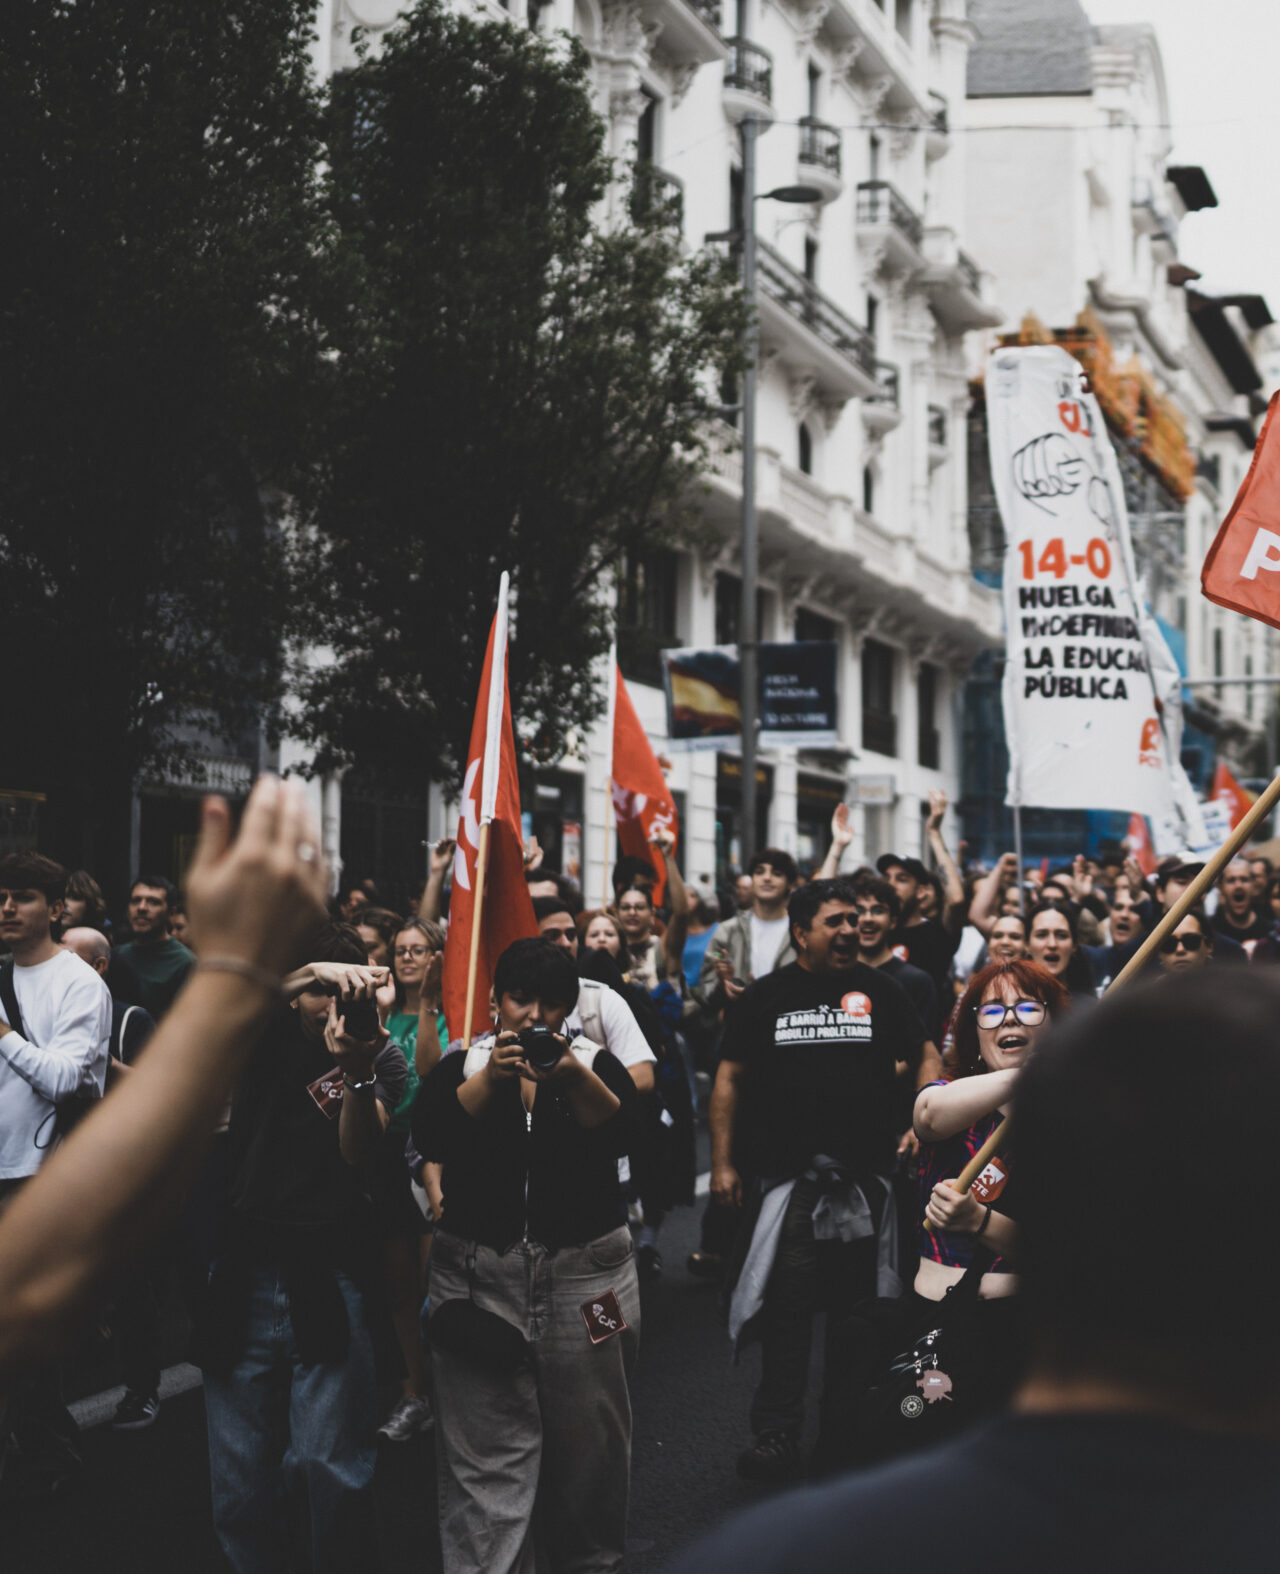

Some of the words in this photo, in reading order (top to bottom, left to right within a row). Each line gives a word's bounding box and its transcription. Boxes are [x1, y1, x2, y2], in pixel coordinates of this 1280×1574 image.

[1018, 584, 1117, 610] HUELGA
[1024, 646, 1054, 669] LA
[1024, 671, 1129, 700] PÚBLICA
[776, 1016, 788, 1029] DE
[790, 1014, 826, 1026] BARRIO
[827, 1013, 835, 1024] A
[775, 1027, 815, 1042] ORGULLO
[817, 1025, 872, 1039] PROLETARIO
[328, 1089, 344, 1099] CJ
[598, 1314, 617, 1329] CJC
